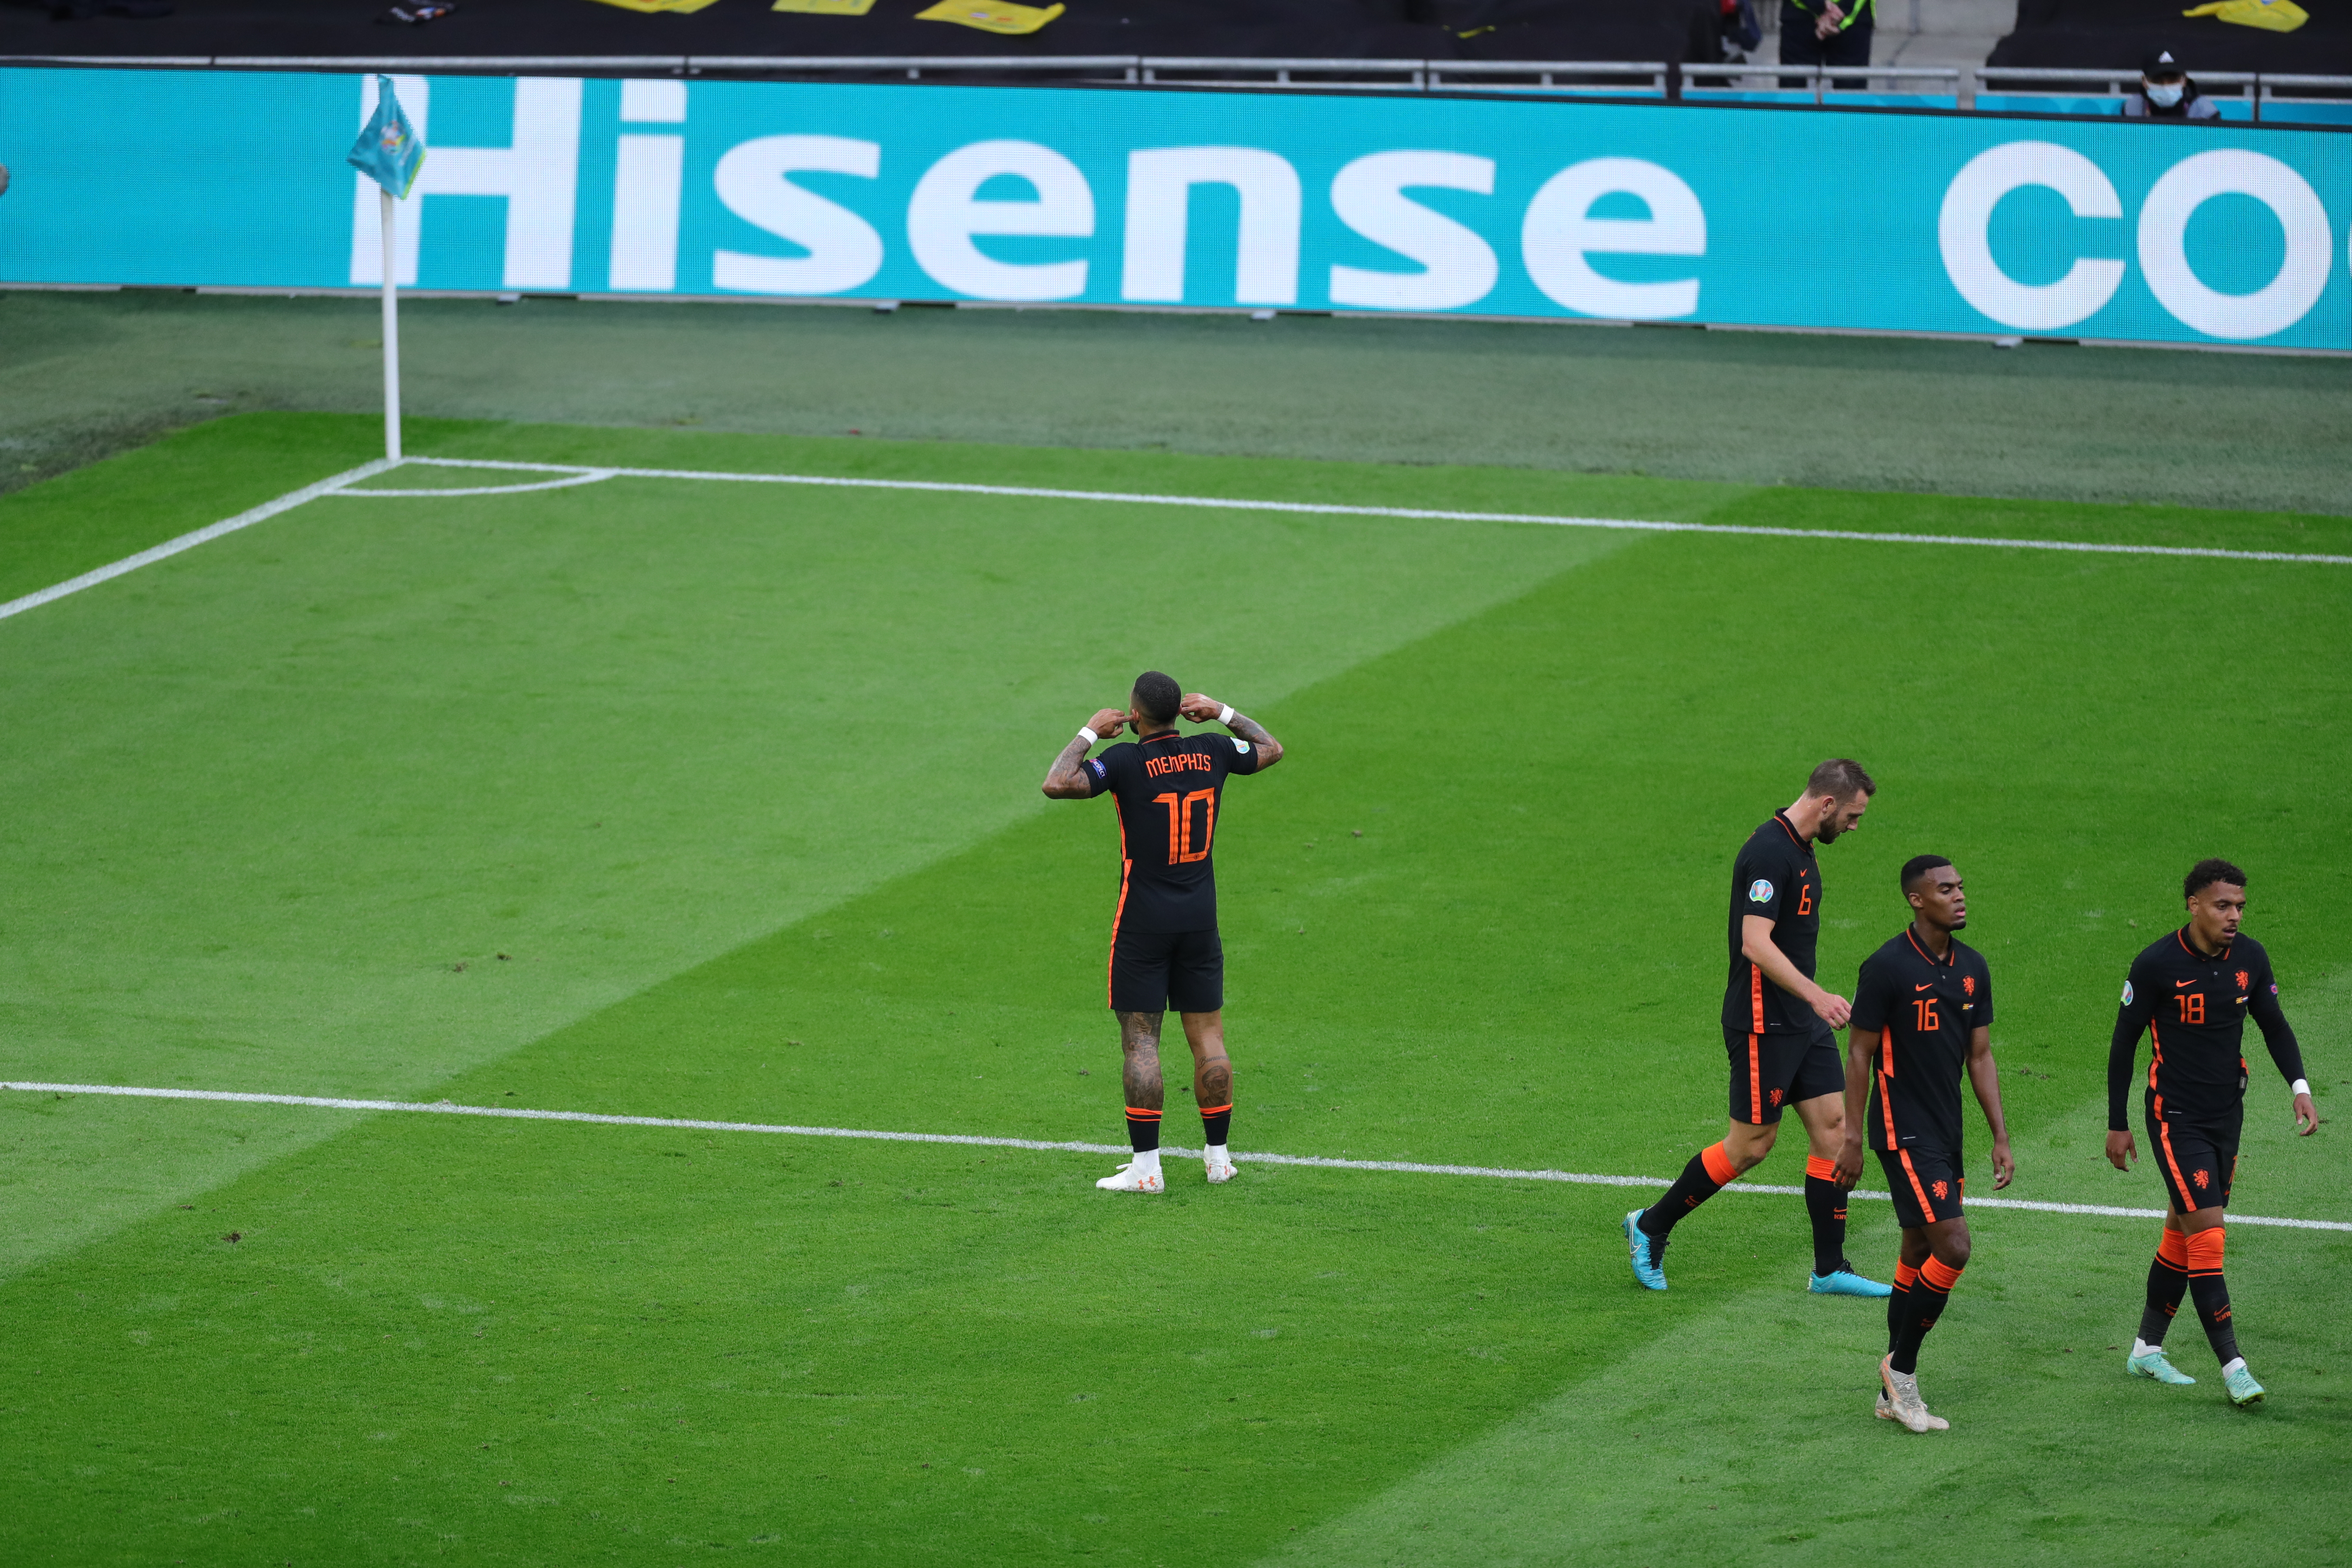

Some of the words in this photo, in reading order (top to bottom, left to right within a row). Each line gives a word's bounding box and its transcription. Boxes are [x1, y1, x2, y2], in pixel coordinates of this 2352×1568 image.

[349, 74, 1707, 319] Hisense
[1939, 141, 2352, 339] CO
[1093, 761, 1105, 777] RESPECT
[1145, 753, 1211, 778] MEMPHIS
[1152, 787, 1215, 865] 10
[1797, 884, 1811, 915] 6
[1911, 998, 1939, 1031] 16
[2174, 993, 2204, 1024] 18
